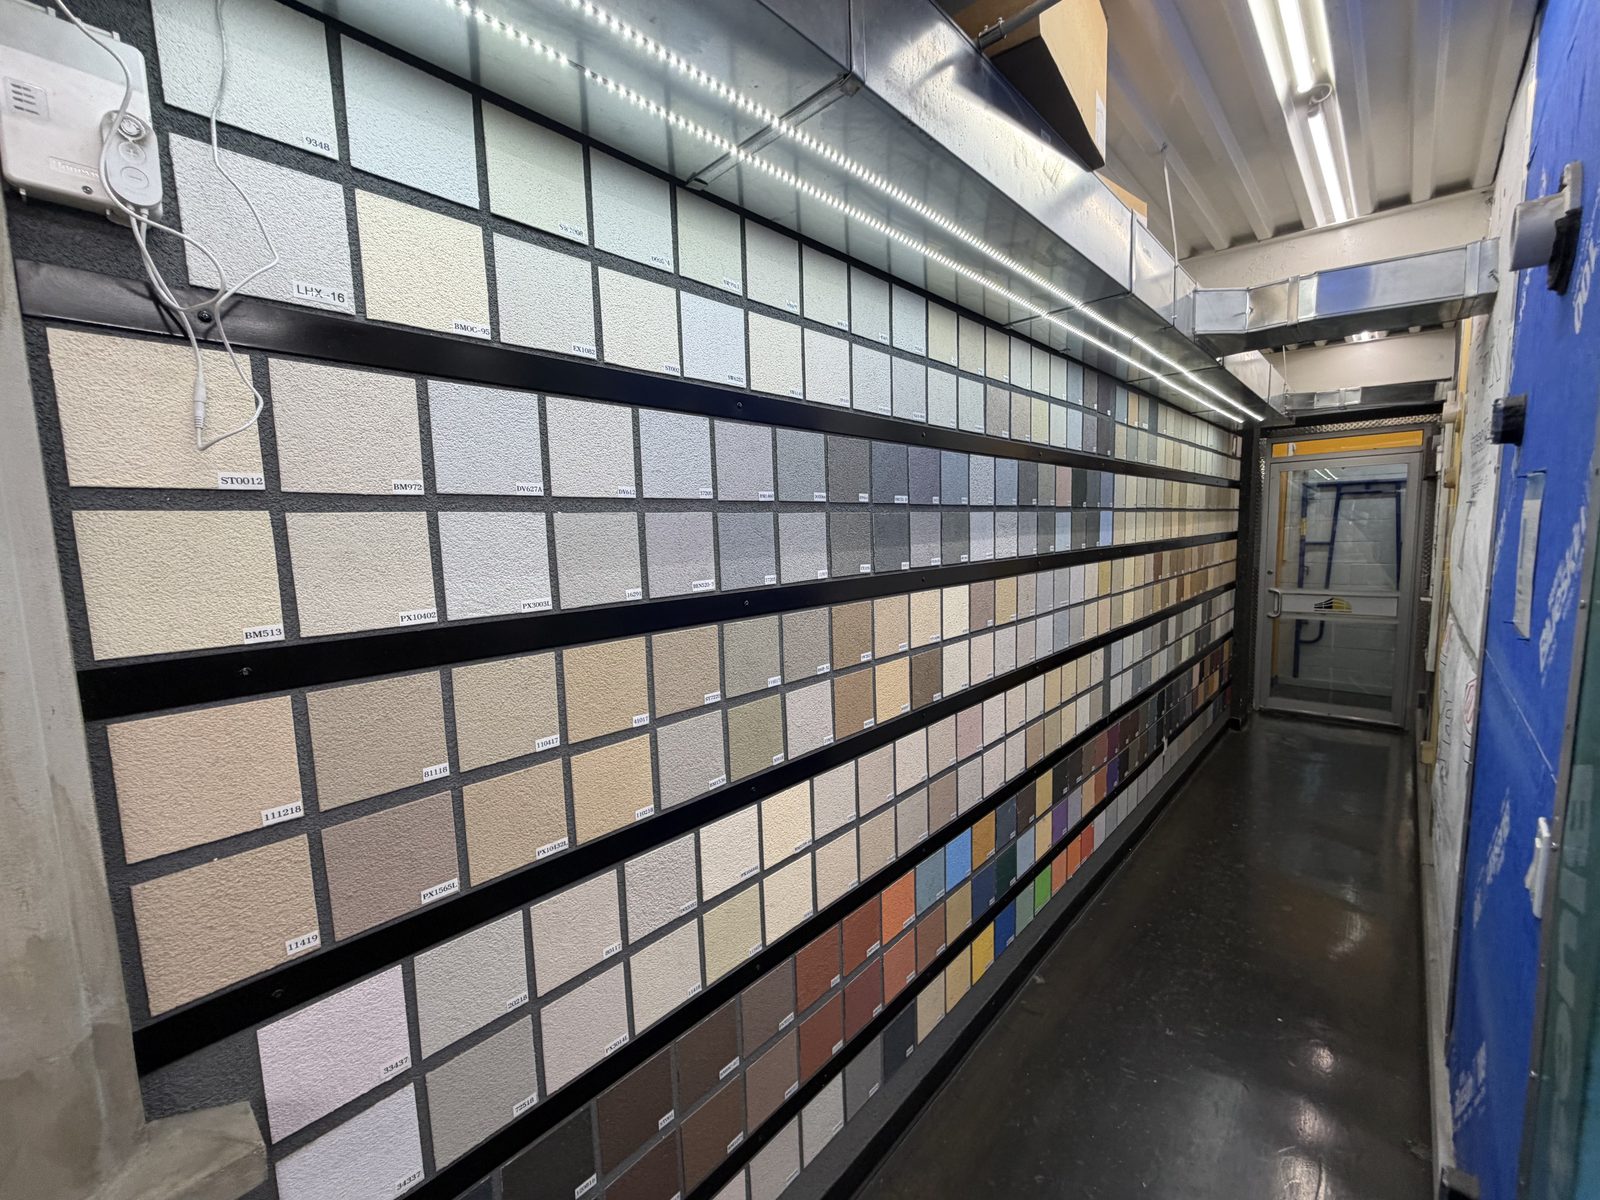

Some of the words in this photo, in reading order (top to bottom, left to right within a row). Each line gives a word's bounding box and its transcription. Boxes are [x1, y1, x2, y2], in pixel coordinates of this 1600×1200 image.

[305, 136, 331, 151] 9348
[453, 323, 490, 335] BMOC-95
[220, 476, 264, 486] ST0012
[393, 483, 423, 491] BM972
[516, 485, 544, 494] DV627A
[400, 612, 437, 623] PX10402
[244, 628, 283, 640] BM513
[424, 766, 449, 779] 81118
[264, 804, 302, 822] 111218
[422, 882, 458, 900] PX1565L
[287, 934, 318, 951] 11419
[383, 1056, 409, 1074] 33437
